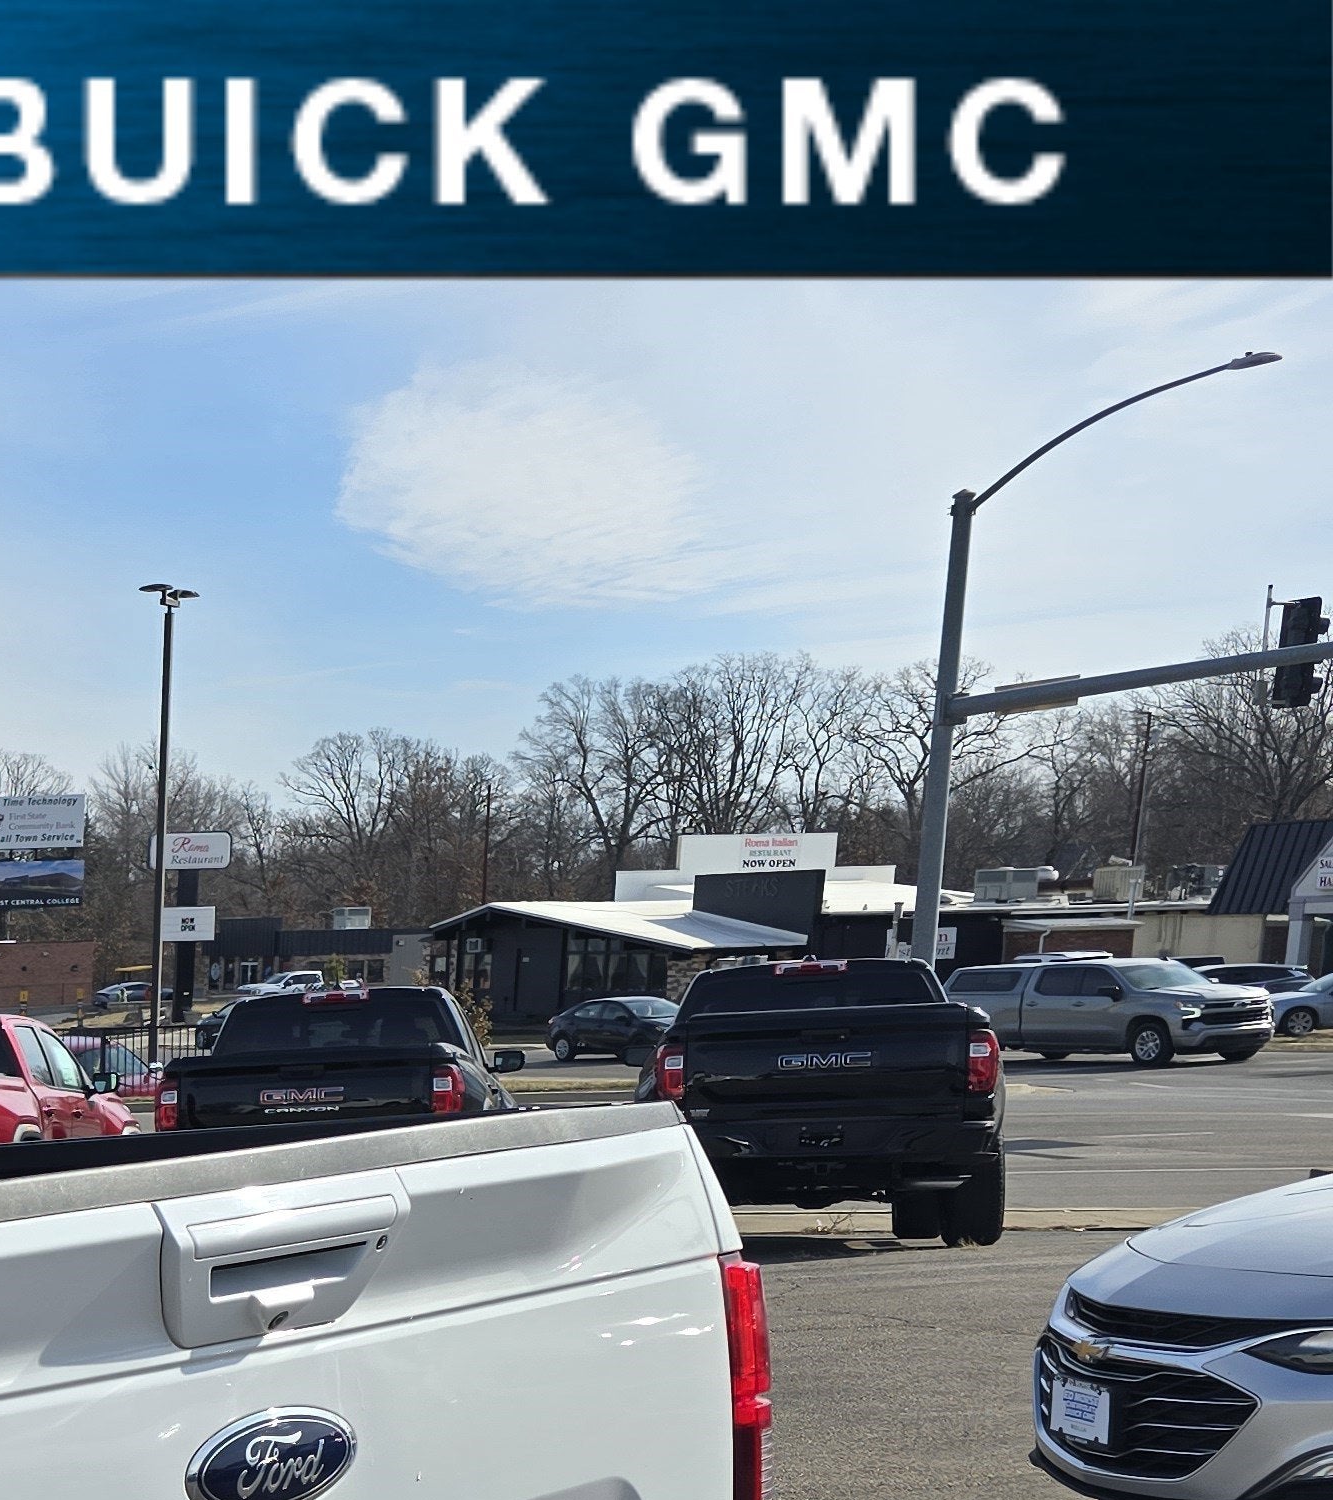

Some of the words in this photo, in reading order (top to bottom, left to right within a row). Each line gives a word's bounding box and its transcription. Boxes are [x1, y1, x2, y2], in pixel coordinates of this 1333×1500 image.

[3, 798, 25, 807] Time
[28, 796, 78, 807] Technology
[9, 812, 27, 820] First
[27, 811, 47, 820] State
[8, 822, 54, 831] Community
[55, 821, 76, 830] Bank
[15, 834, 38, 843] Town
[41, 833, 75, 842] Service
[744, 838, 770, 848] Roma
[771, 838, 798, 847] Italian
[749, 849, 792, 857] RESTAURANT
[171, 855, 224, 865] Restaurant
[742, 859, 767, 868] NOW
[768, 858, 797, 868] OPEN
[46, 897, 80, 905] COLLEGE
[180, 924, 196, 932] OPEN
[777, 1051, 872, 1071] GMC
[259, 1086, 344, 1105] GMC
[264, 1105, 340, 1114] CANYON
[236, 1430, 325, 1500] Ford
